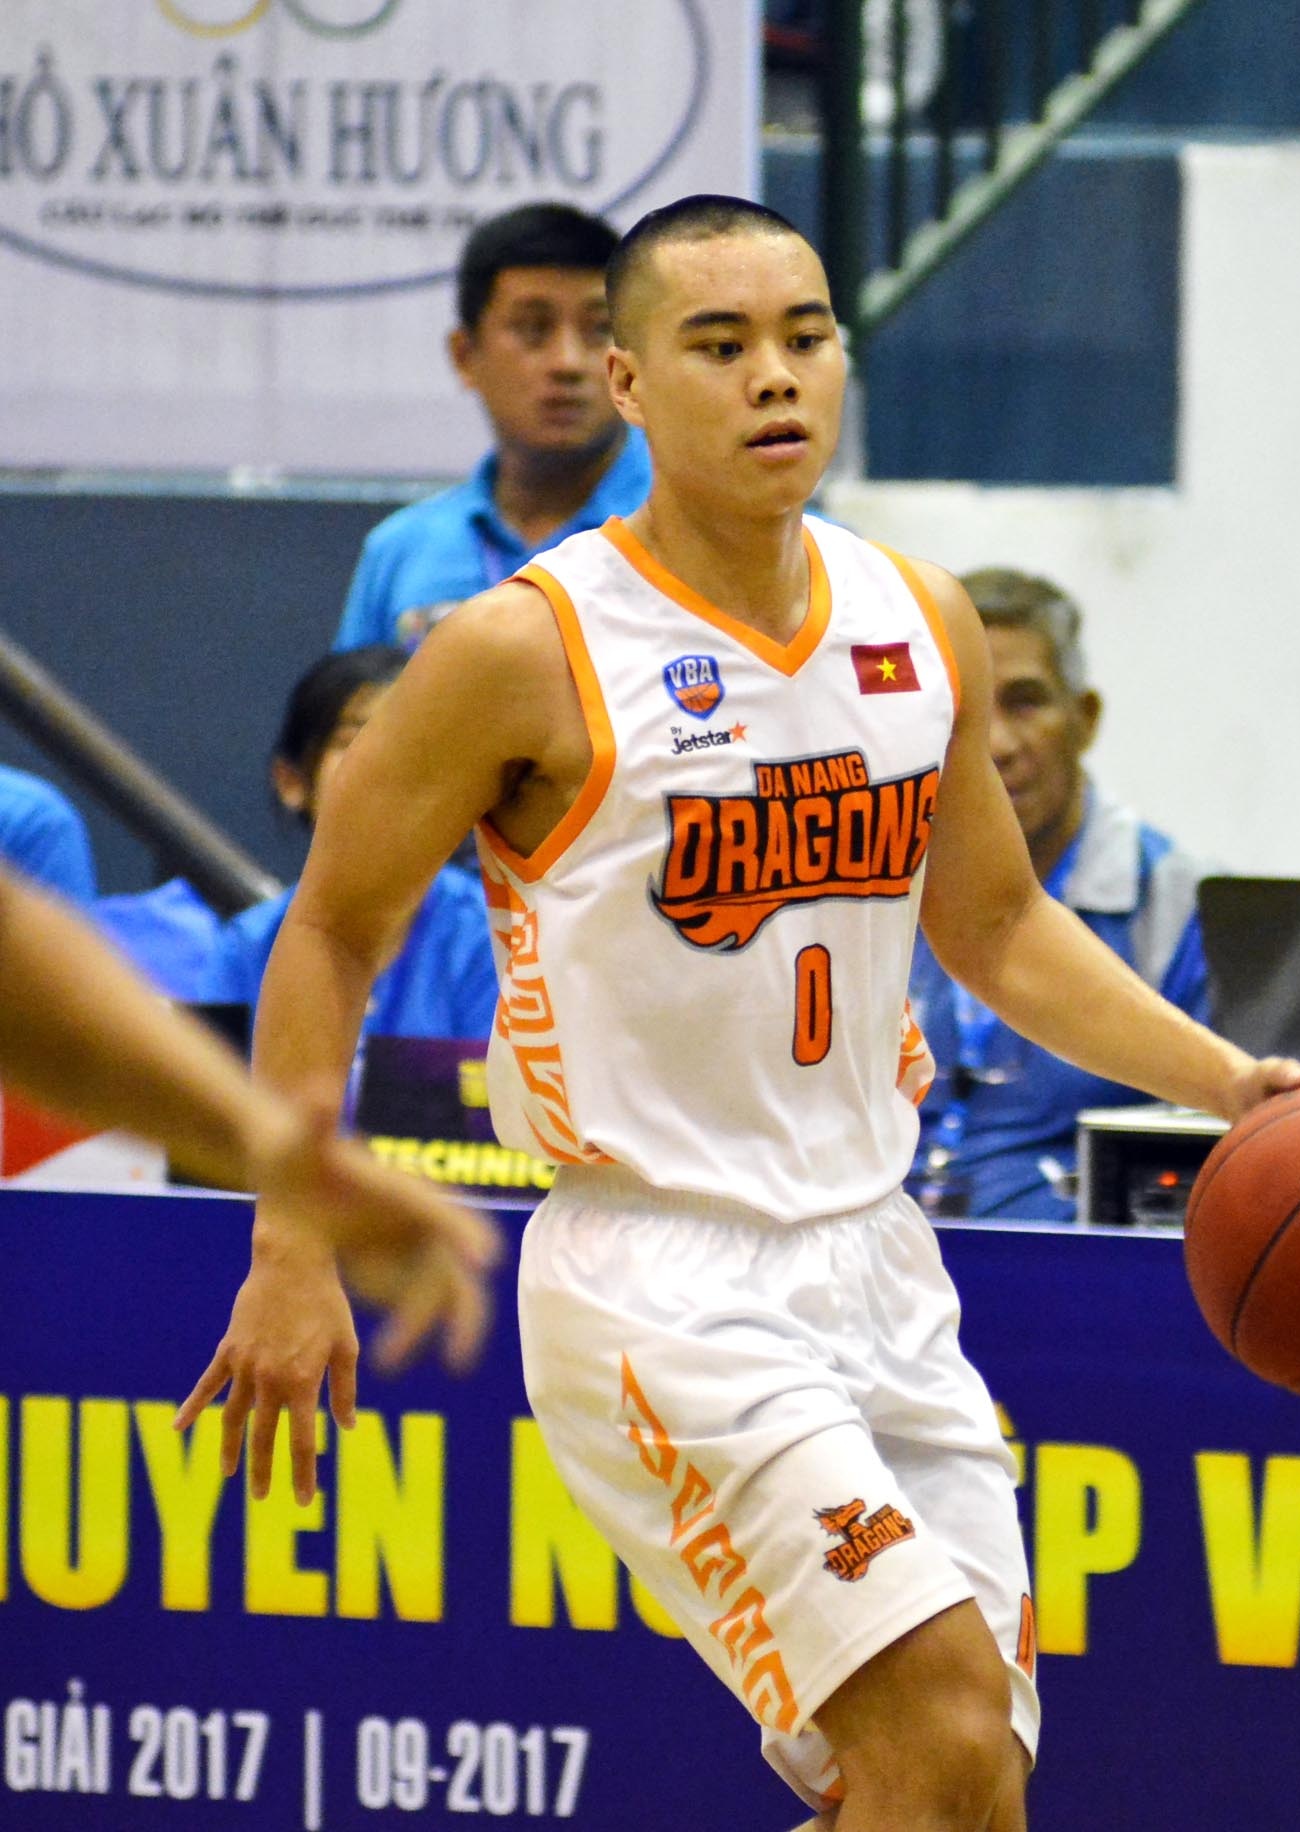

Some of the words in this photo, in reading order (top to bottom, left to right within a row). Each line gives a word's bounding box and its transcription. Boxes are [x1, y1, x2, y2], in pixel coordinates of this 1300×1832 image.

[90, 52, 305, 186] XUÂN
[667, 658, 714, 689] VBA
[670, 726, 682, 735] By
[671, 730, 732, 755] Jetstar
[756, 765, 789, 798] DA
[790, 752, 869, 797] NANG
[664, 769, 940, 899] DRAGONS
[793, 943, 831, 1066] 0
[4, 1677, 112, 1794] GIẢI
[127, 1703, 270, 1801] 2017
[357, 1715, 590, 1818] 09-2017
